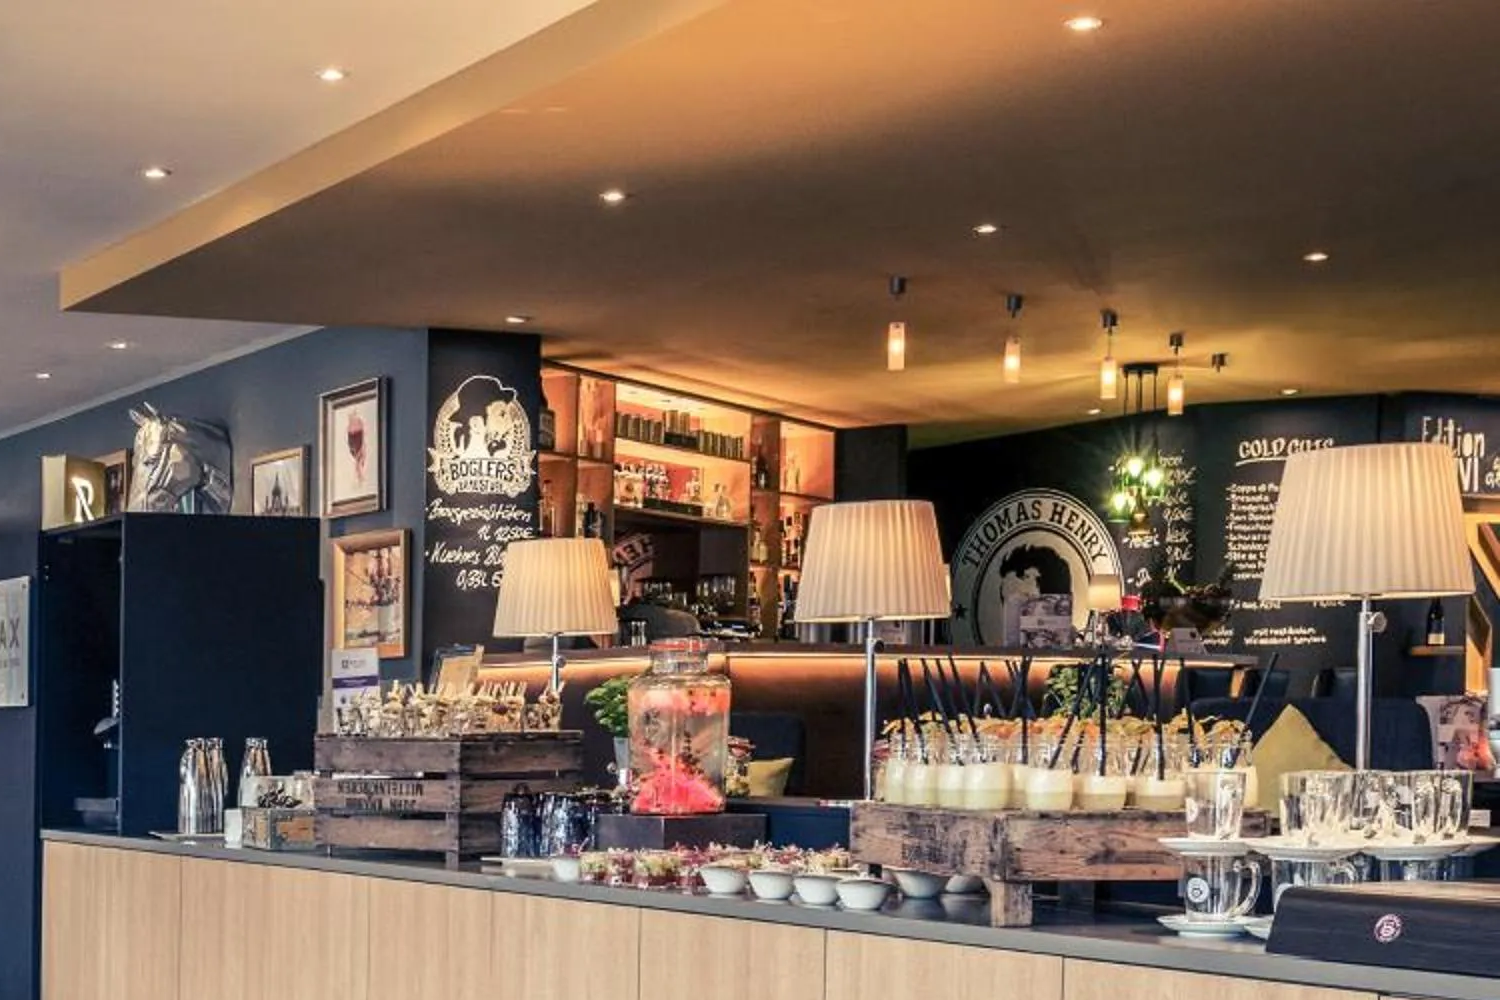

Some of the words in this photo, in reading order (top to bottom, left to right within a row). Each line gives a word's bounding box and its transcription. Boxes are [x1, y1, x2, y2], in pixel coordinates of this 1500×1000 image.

[1239, 438, 1286, 459] COLD
[450, 461, 516, 482] BOGLERS
[71, 476, 94, 522] R
[962, 499, 1042, 568] THOMAS
[1051, 502, 1108, 562] HENRY
